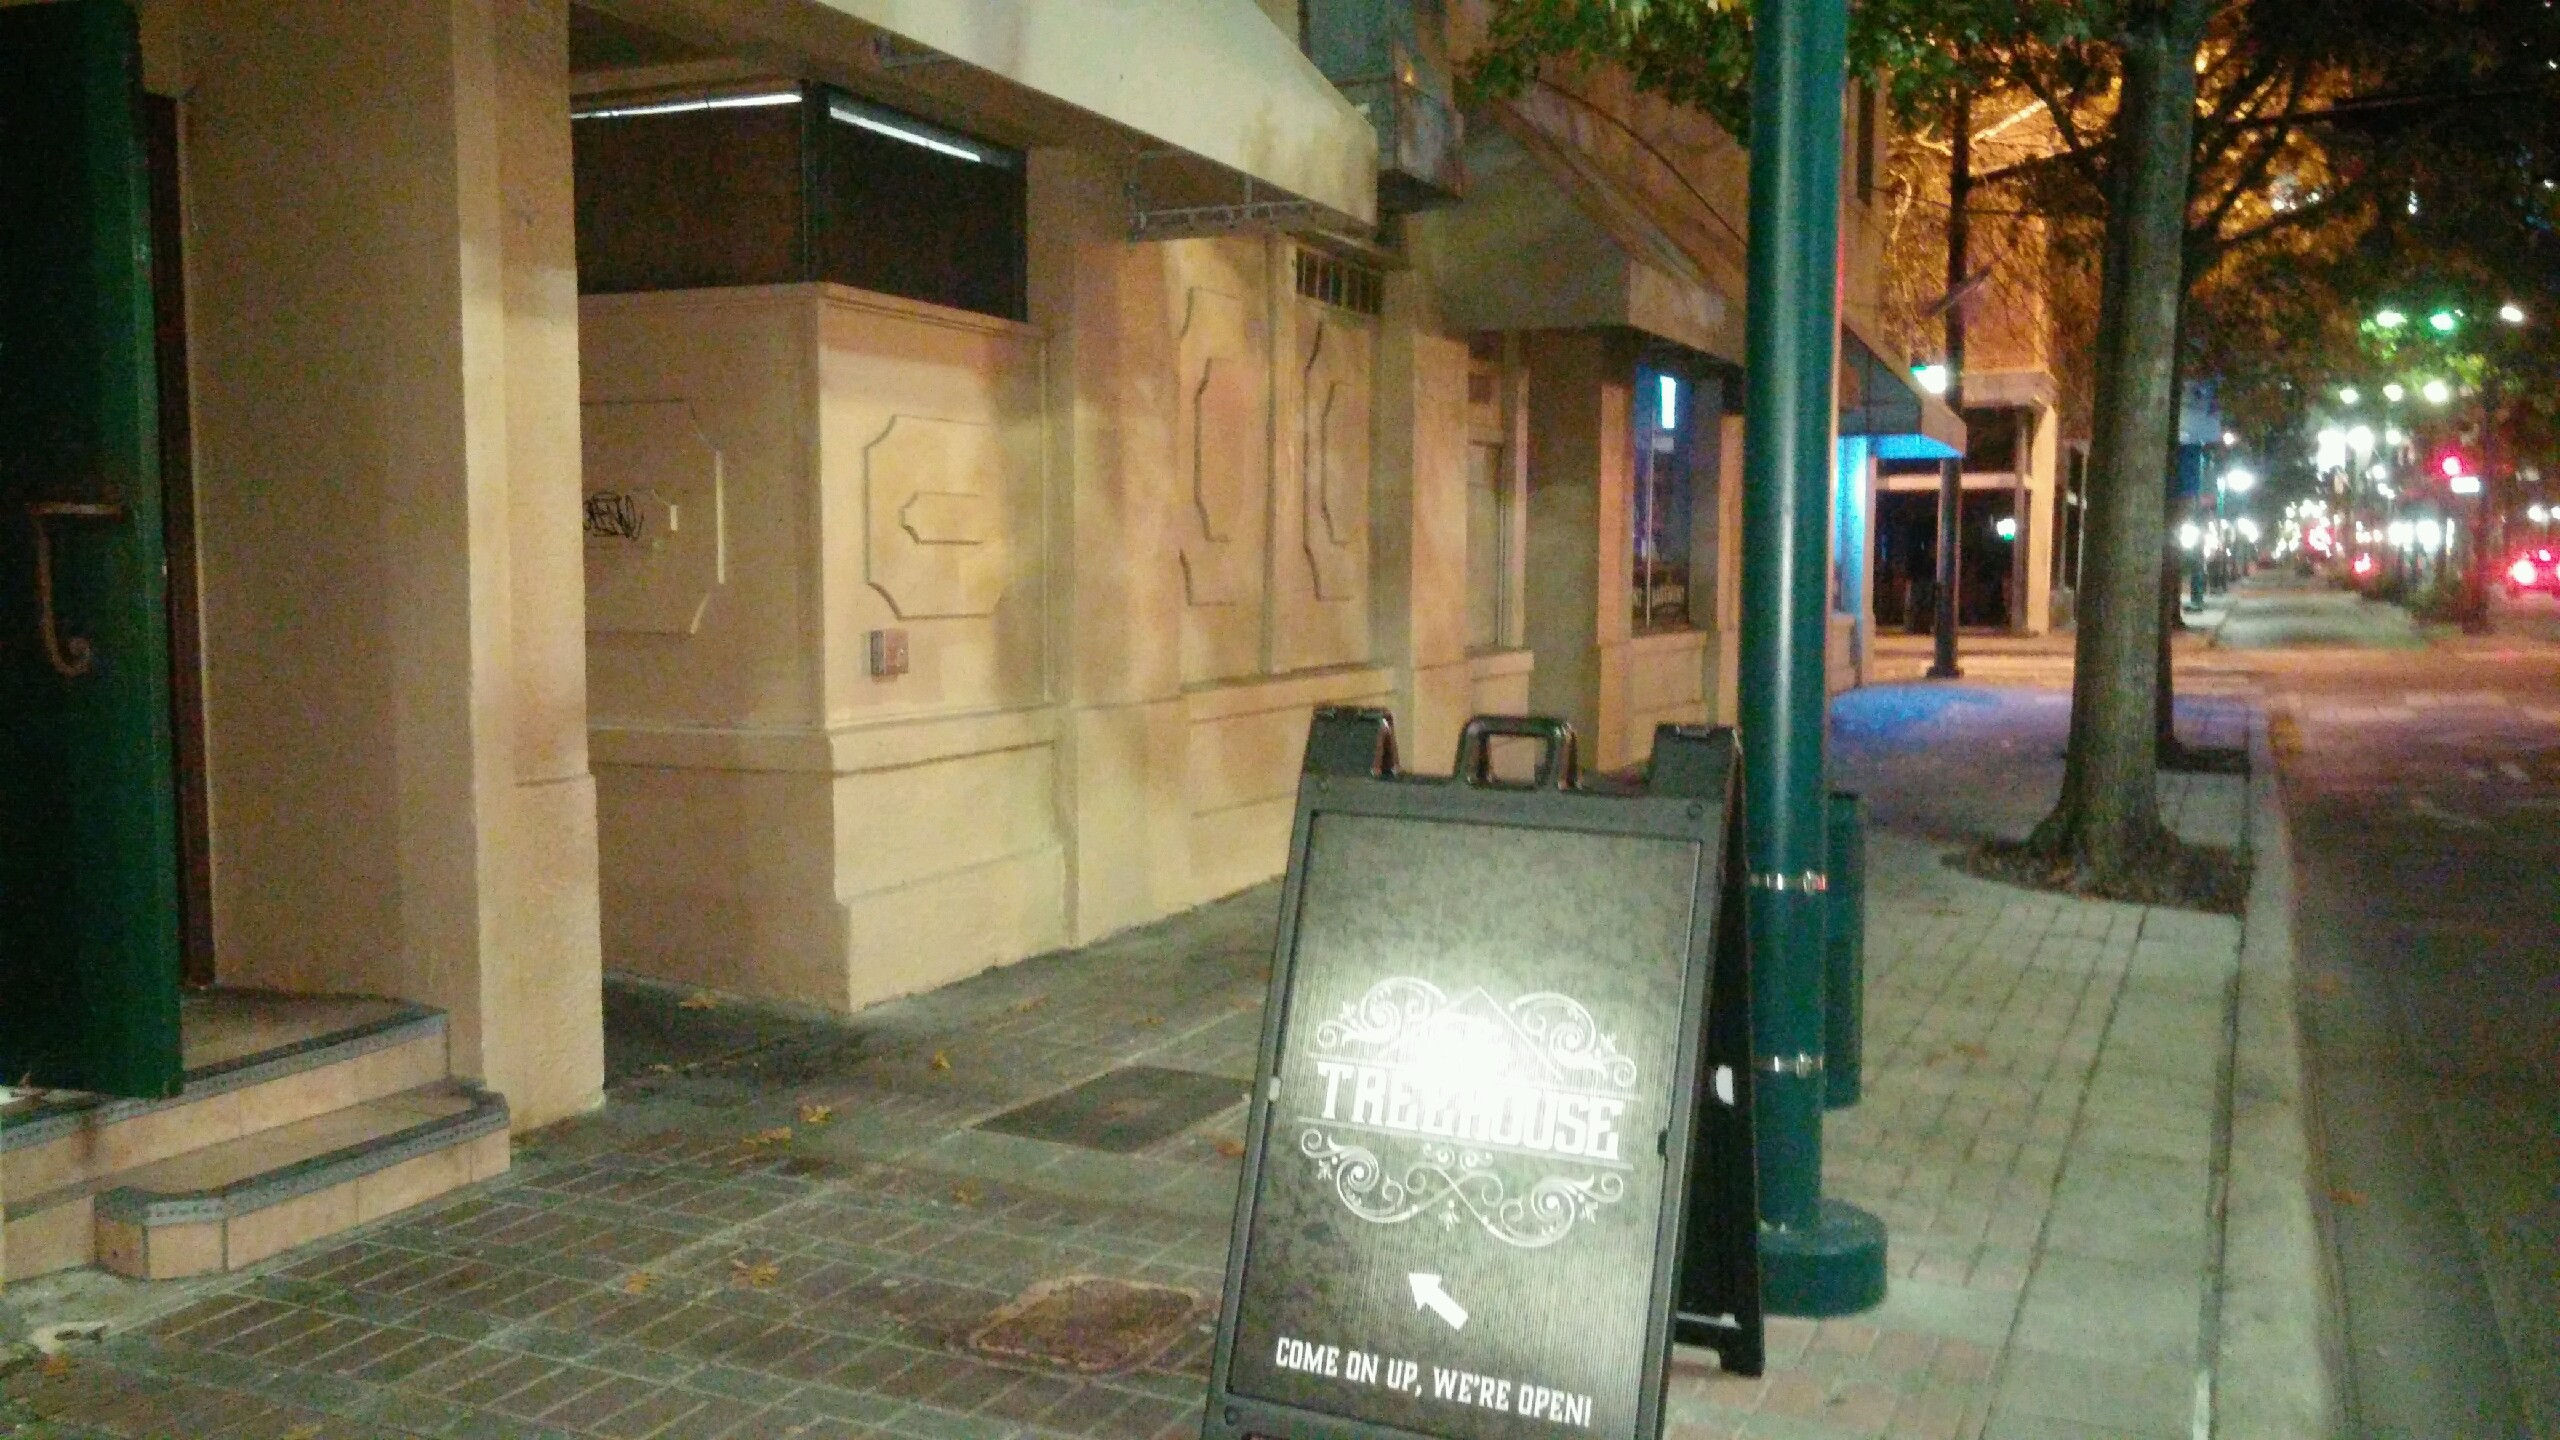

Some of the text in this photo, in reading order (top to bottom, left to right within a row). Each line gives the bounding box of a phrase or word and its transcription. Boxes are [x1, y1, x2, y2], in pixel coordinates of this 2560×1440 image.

[1316, 1060, 1625, 1161] TREEHOUSE
[1275, 1336, 1592, 1428] COME ON UP, WE'RE OPEN!
